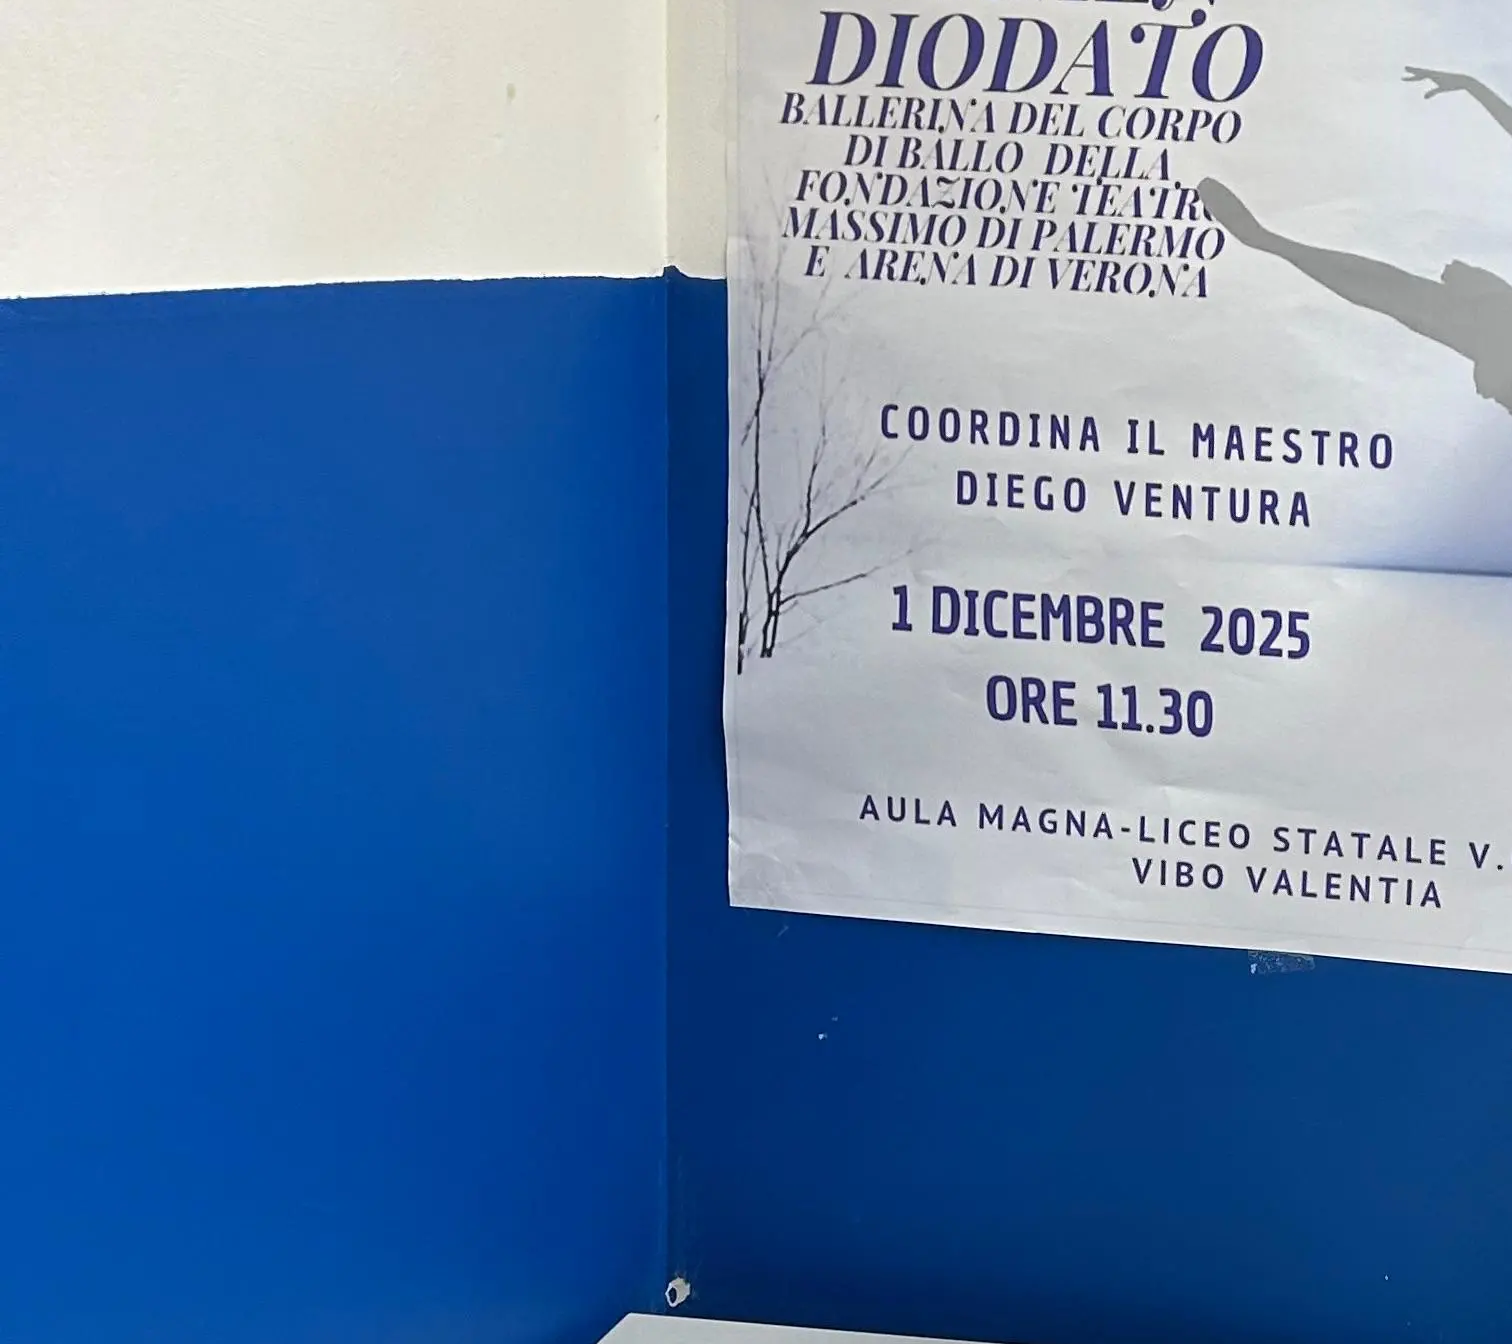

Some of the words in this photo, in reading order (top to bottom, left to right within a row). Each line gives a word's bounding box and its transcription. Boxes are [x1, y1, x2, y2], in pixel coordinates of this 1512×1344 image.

[805, 9, 1264, 103] DIODATO
[780, 92, 995, 134] BALLERINA
[1008, 102, 1085, 137] DEL
[1098, 105, 1242, 144] CORPO
[844, 134, 887, 168] DI
[898, 137, 1023, 174] BALLO
[1044, 143, 1170, 182] DELLA
[795, 169, 1060, 214] FONDAZIONE
[782, 206, 966, 248] MASSIMO
[977, 218, 1018, 250] DI
[1032, 220, 1225, 262] PALERMO
[804, 245, 829, 278] E
[845, 248, 977, 286] ARENA
[990, 255, 1031, 289] DI
[1048, 258, 1208, 299] VERONA
[881, 404, 1100, 452] COORDINA
[1127, 419, 1165, 455] IL
[1192, 422, 1392, 469] MAESTRO
[956, 470, 1086, 513] DIEGO
[1114, 480, 1310, 527] VENTURA
[891, 585, 912, 632] 1
[931, 585, 1165, 648] DICEMBRE
[1200, 606, 1310, 659] 2025
[986, 675, 1077, 726] ORE
[1097, 682, 1214, 737] 11.30
[860, 794, 956, 827] AULA
[978, 803, 1250, 849] MAGNA-LICEO
[1273, 827, 1446, 865] STATALE
[1132, 858, 1224, 890] VIBO
[1246, 866, 1442, 908] VALENTIA
